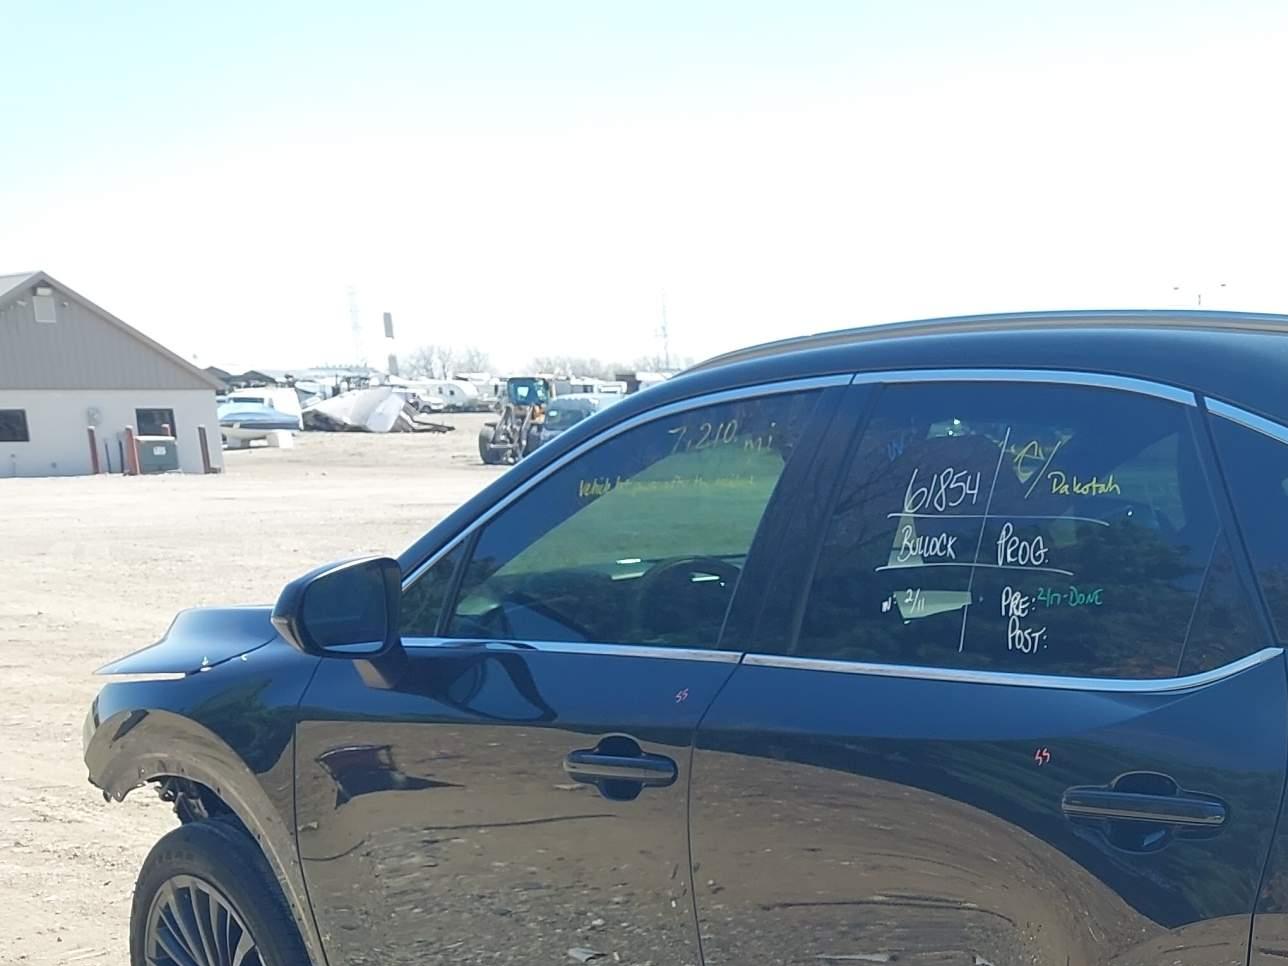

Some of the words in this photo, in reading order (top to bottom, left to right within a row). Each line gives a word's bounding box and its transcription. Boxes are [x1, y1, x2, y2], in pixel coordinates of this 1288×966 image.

[903, 467, 982, 514] 61854
[1047, 470, 1121, 496] Dakotah
[897, 525, 957, 562] BULLOCK
[1007, 615, 1049, 653] POST:
